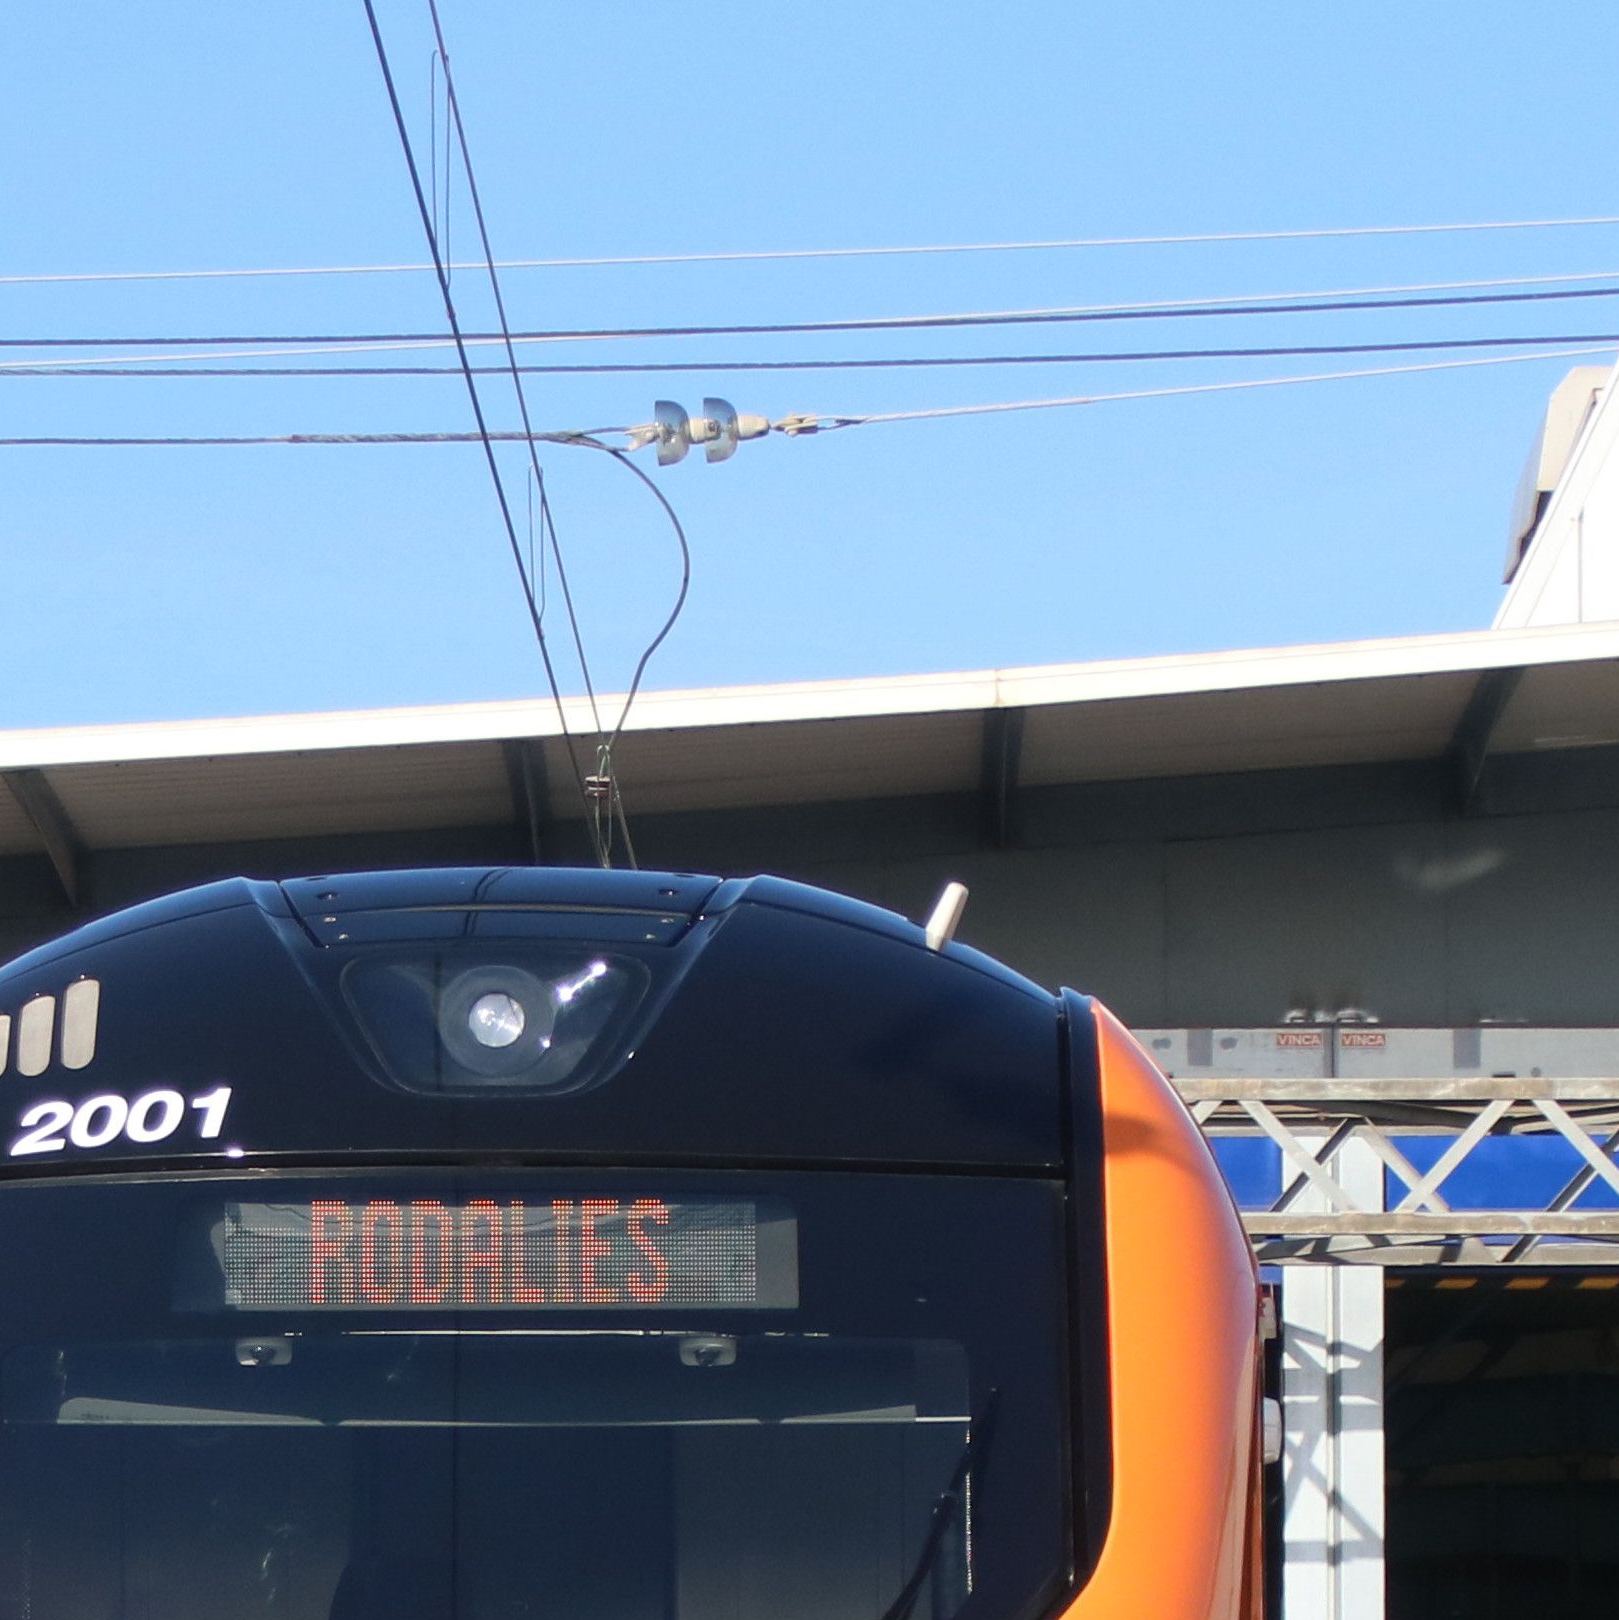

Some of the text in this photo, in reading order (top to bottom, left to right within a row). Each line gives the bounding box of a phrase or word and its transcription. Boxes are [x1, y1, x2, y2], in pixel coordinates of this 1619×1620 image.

[1278, 1033, 1321, 1046] VINCA
[1343, 1033, 1385, 1046] VINCA
[10, 1087, 233, 1157] 2001
[311, 1199, 670, 1304] RODALIES
